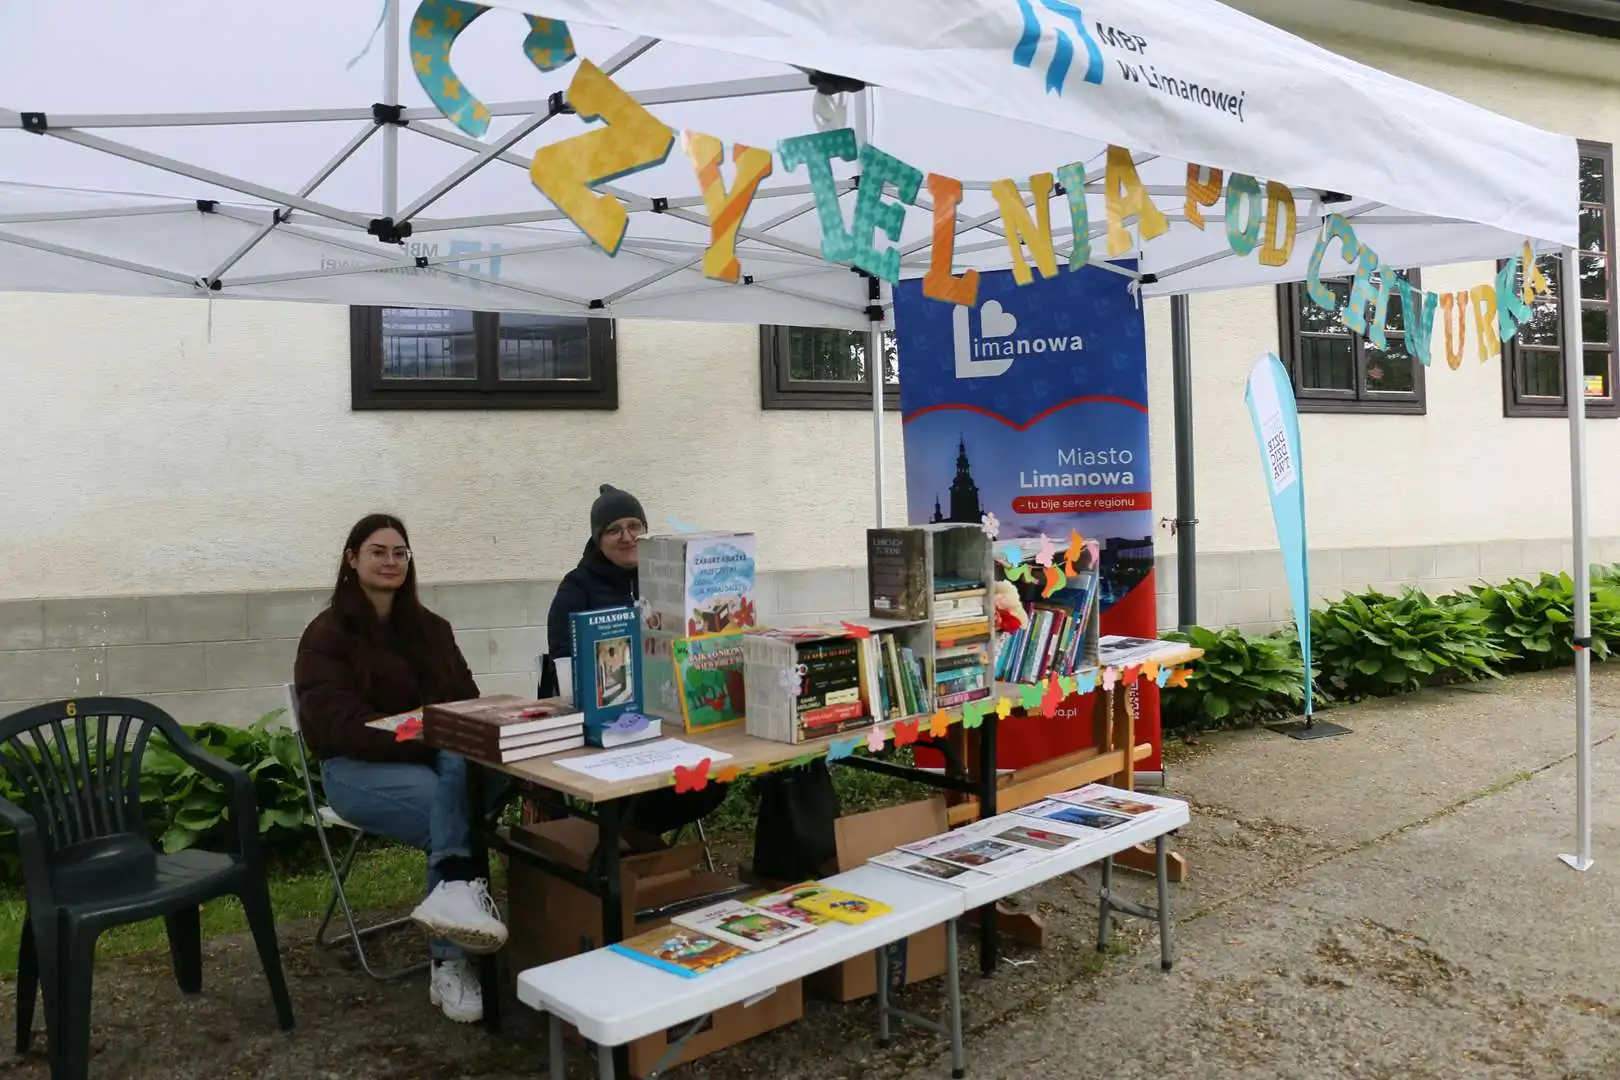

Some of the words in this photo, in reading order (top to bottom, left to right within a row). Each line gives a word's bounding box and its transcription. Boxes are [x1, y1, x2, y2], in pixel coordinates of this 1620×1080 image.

[1096, 21, 1147, 55] MBP
[1117, 59, 1138, 83] w
[1139, 64, 1245, 123] Limanowej
[409, 0, 1170, 309] CZYTELNIA
[1184, 162, 1297, 267] POD
[1058, 448, 1133, 466] Miasto
[1020, 470, 1135, 489] Limanowa
[1028, 500, 1038, 510] tu
[1041, 499, 1061, 511] bije
[1062, 498, 1092, 509] serce
[1094, 497, 1136, 509] regionu
[589, 611, 636, 625] LIMANOWA
[66, 701, 77, 717] 6
